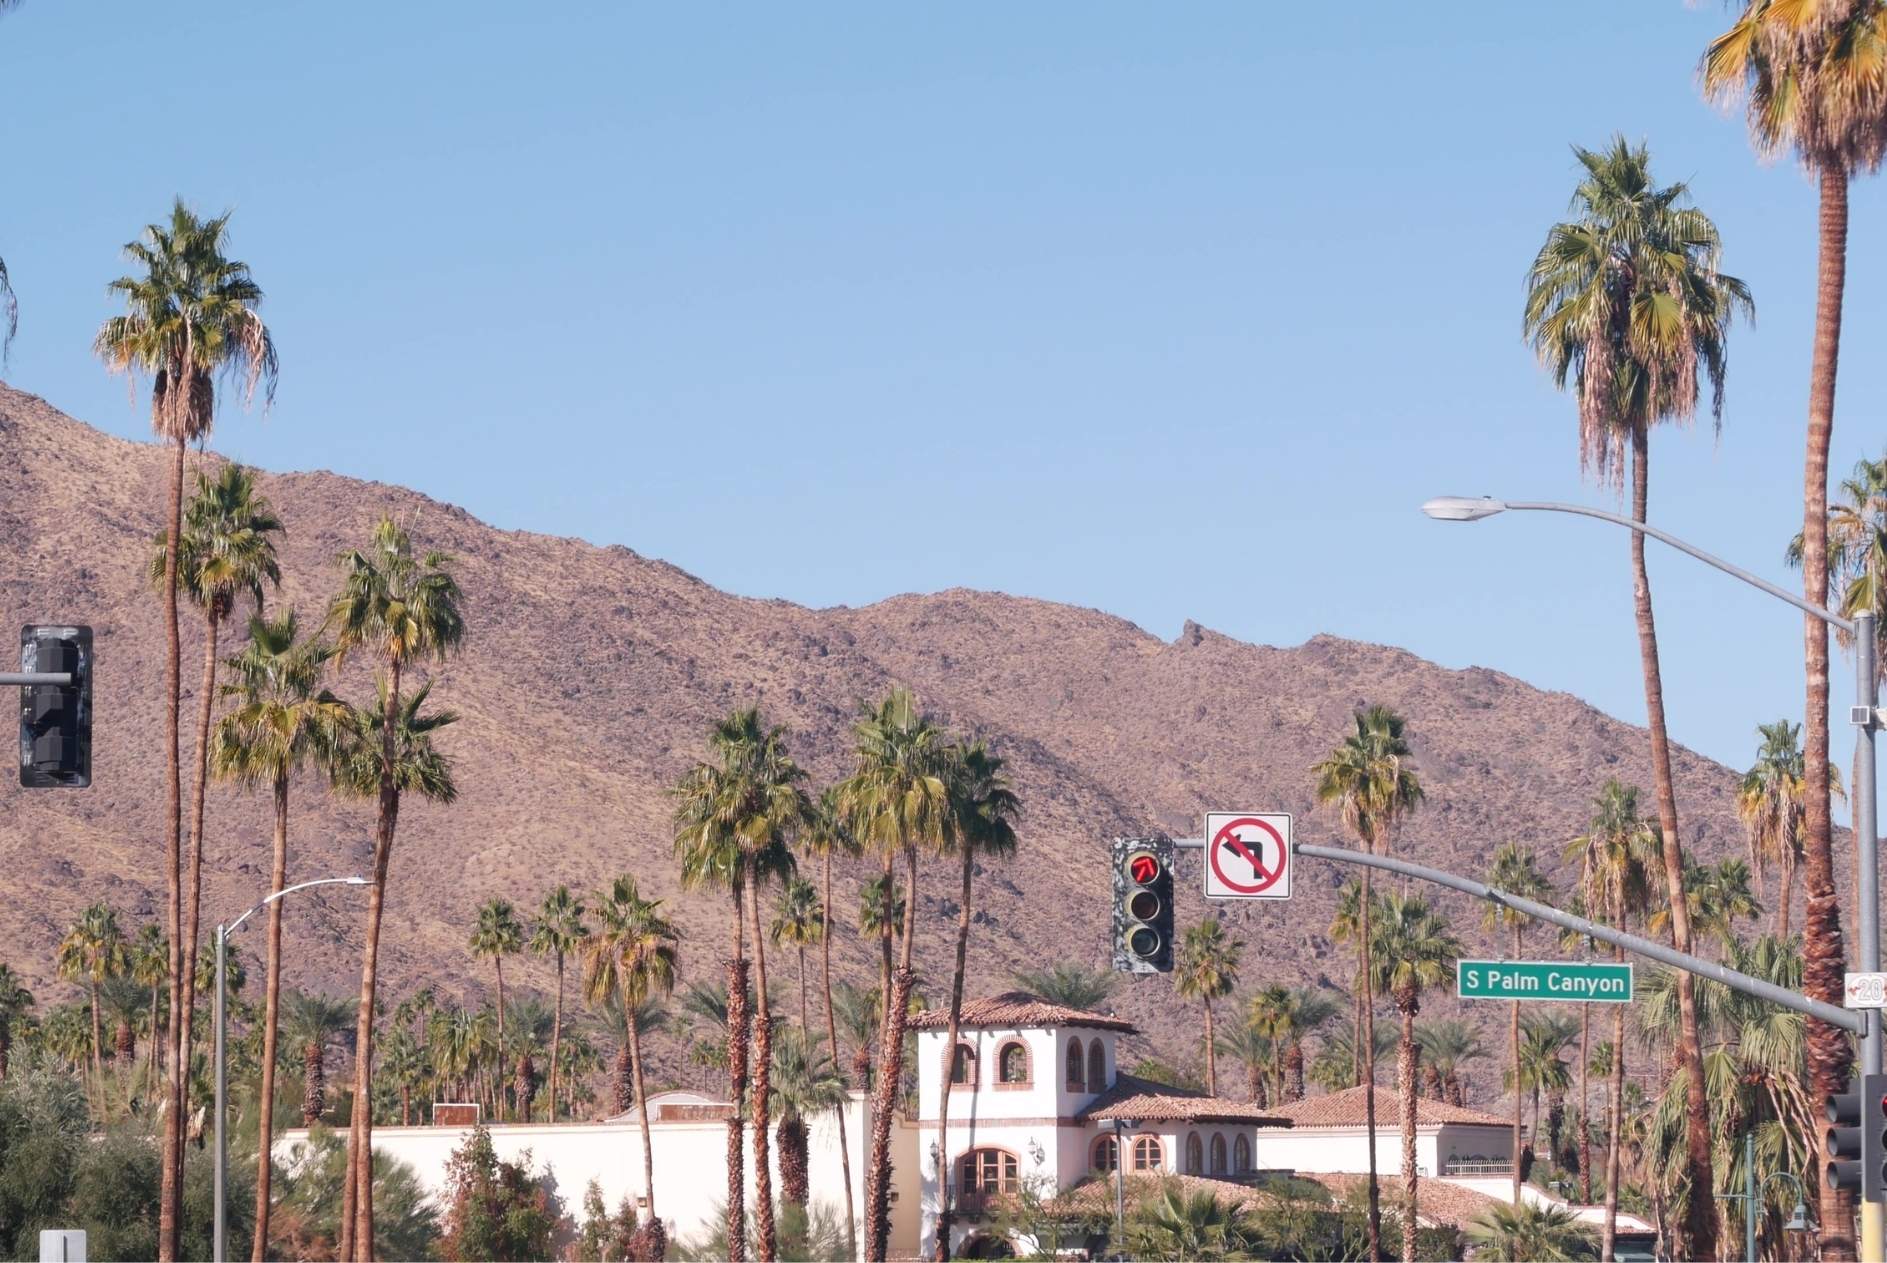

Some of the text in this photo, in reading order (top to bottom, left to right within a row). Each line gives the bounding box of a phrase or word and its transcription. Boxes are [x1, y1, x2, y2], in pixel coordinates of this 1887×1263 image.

[1466, 970, 1624, 996] S Palm Canyon
